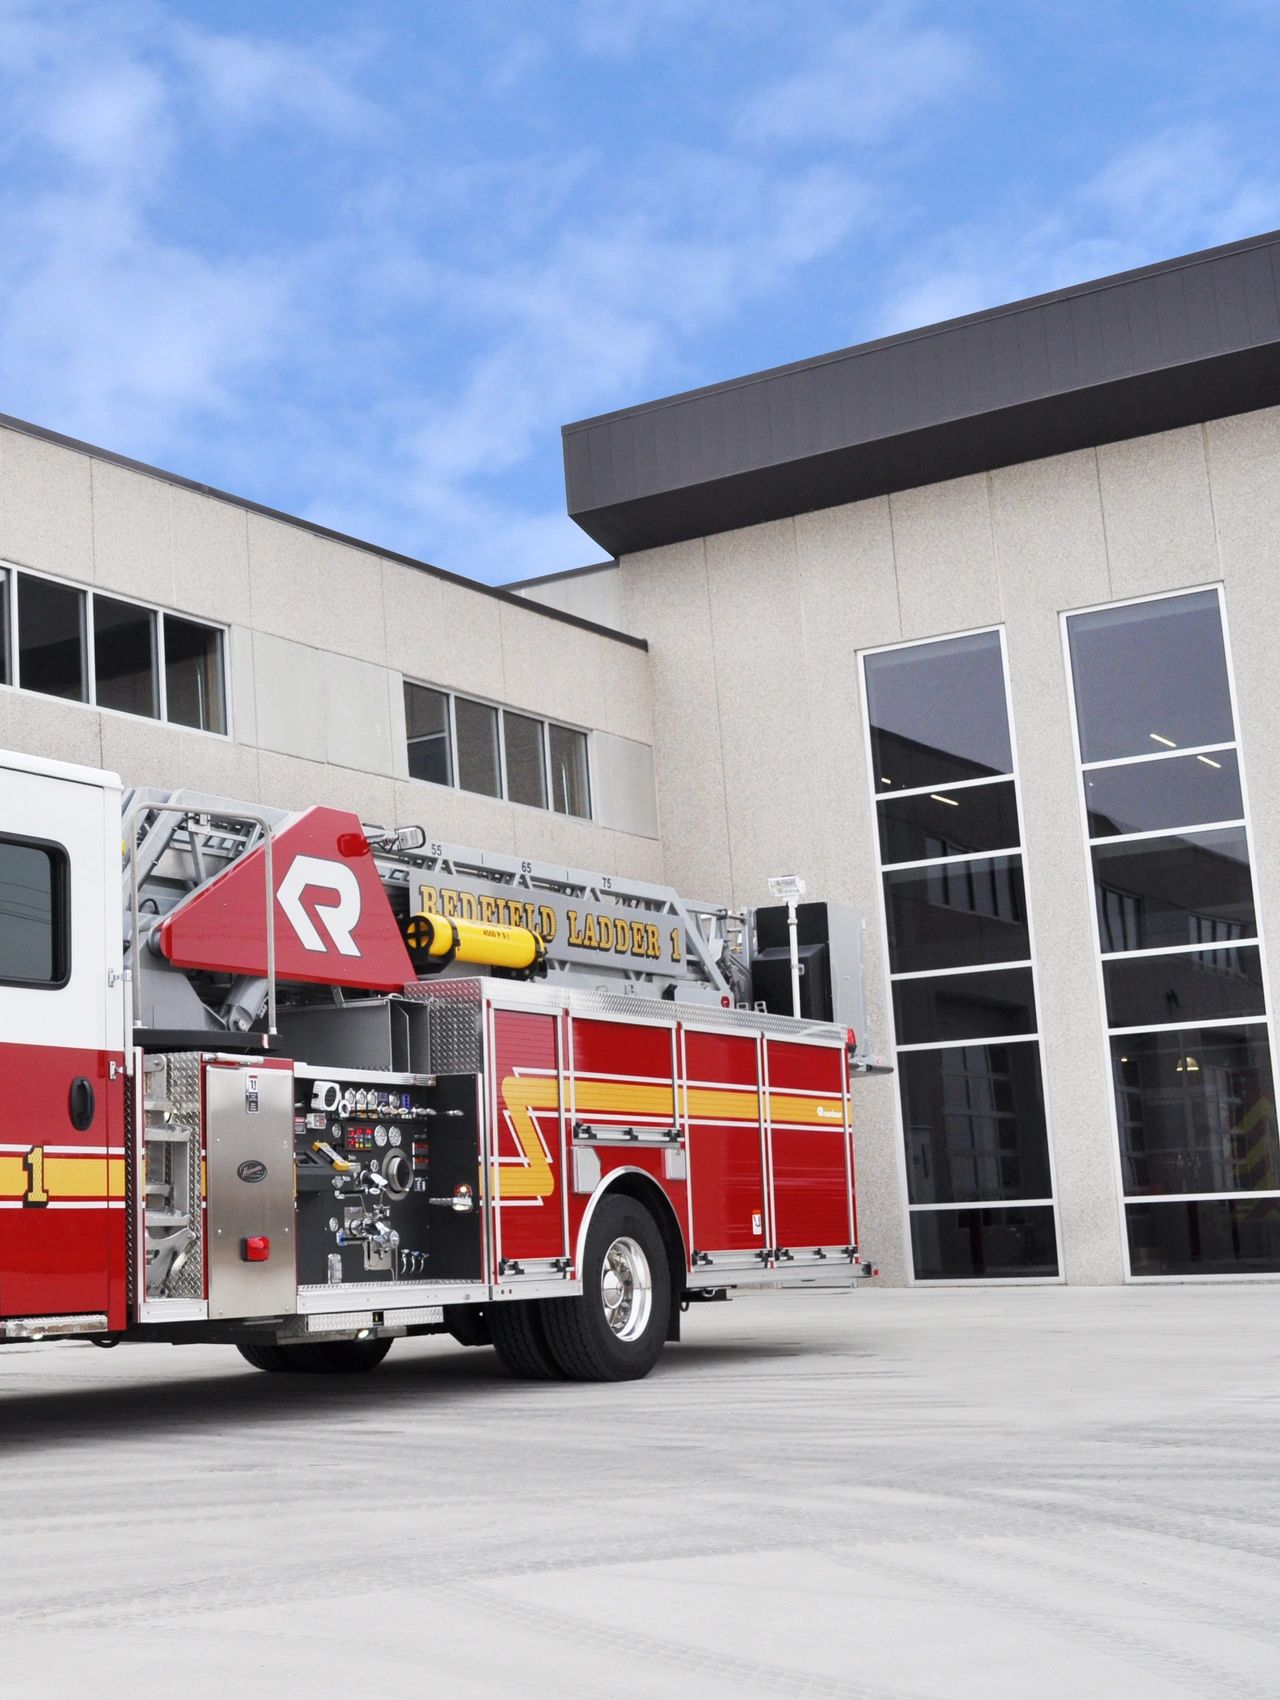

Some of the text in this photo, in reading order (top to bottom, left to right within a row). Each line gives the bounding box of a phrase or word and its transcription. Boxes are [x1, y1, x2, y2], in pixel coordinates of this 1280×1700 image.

[431, 844, 443, 857] 55
[521, 861, 533, 874] 65
[601, 877, 612, 889] 75
[419, 885, 681, 962] REDFIELD LADDER 1
[24, 1146, 49, 1207] 1
